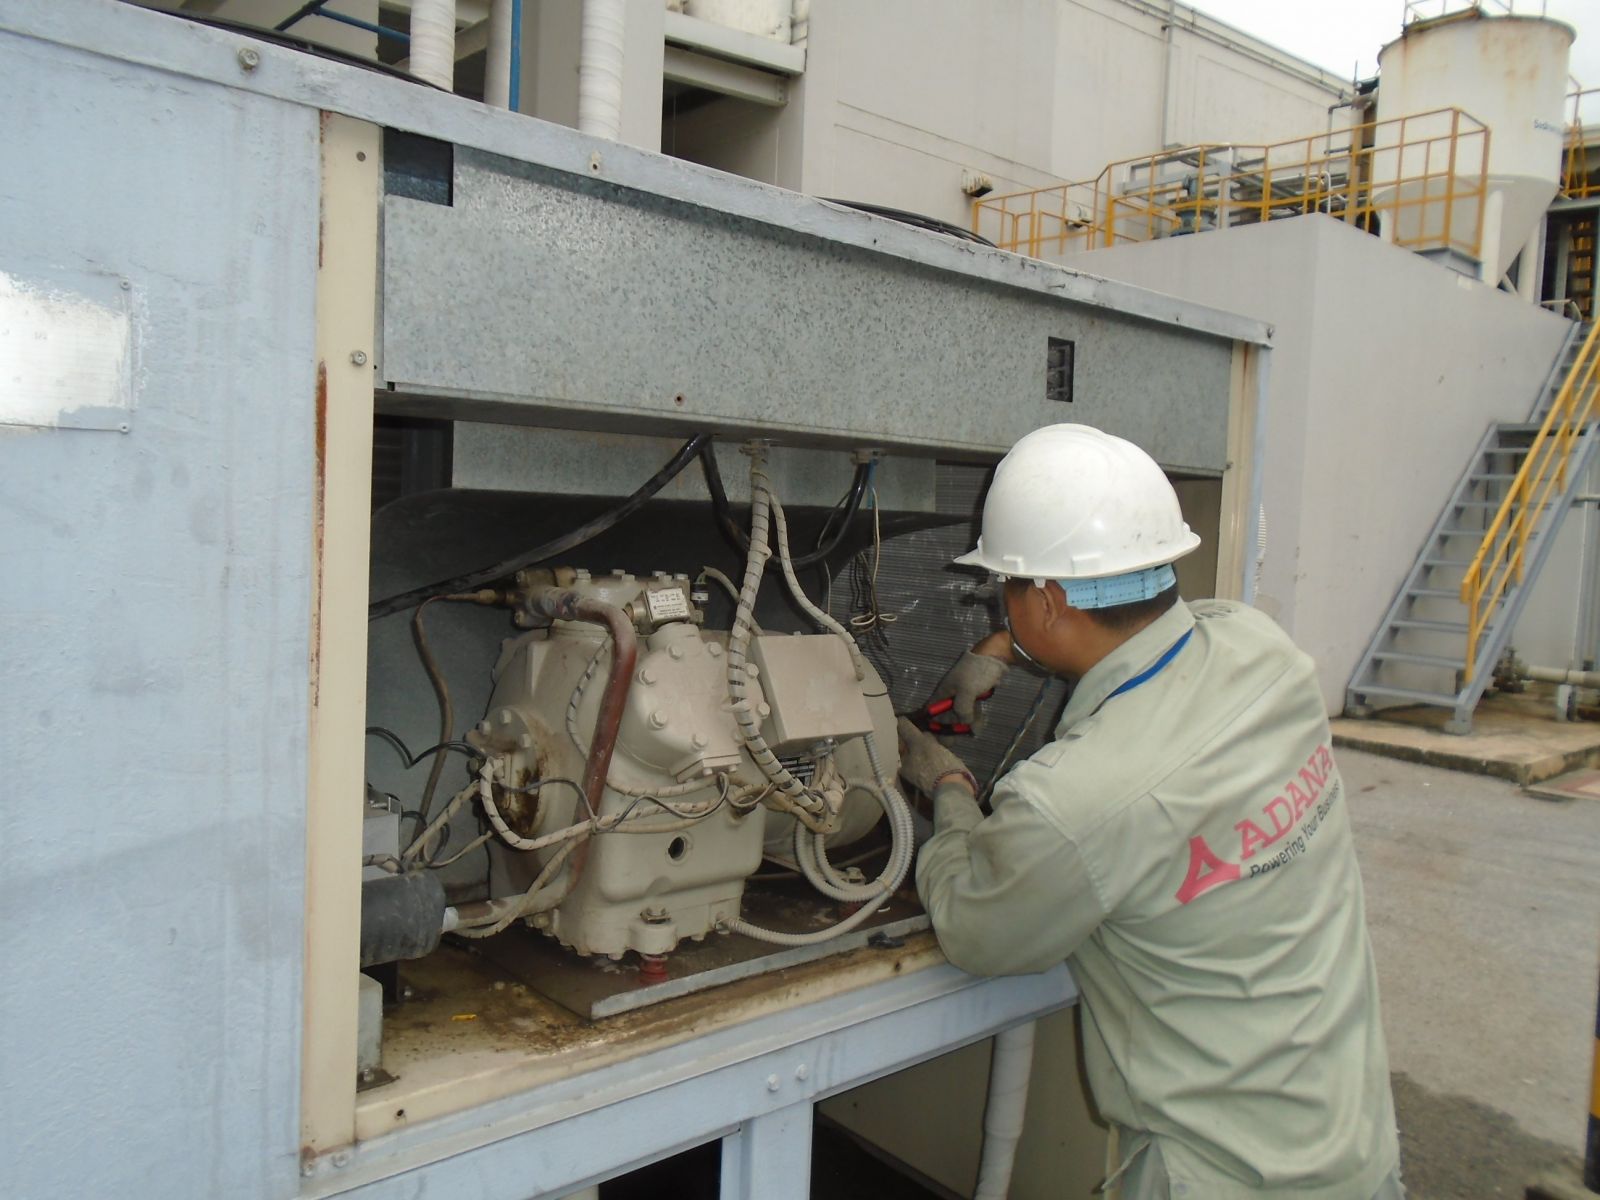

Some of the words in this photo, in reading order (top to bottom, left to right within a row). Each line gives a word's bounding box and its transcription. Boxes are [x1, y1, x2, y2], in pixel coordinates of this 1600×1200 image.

[1233, 744, 1334, 860] ADANA
[1249, 836, 1307, 878] Powering
[1301, 817, 1319, 840] Your
